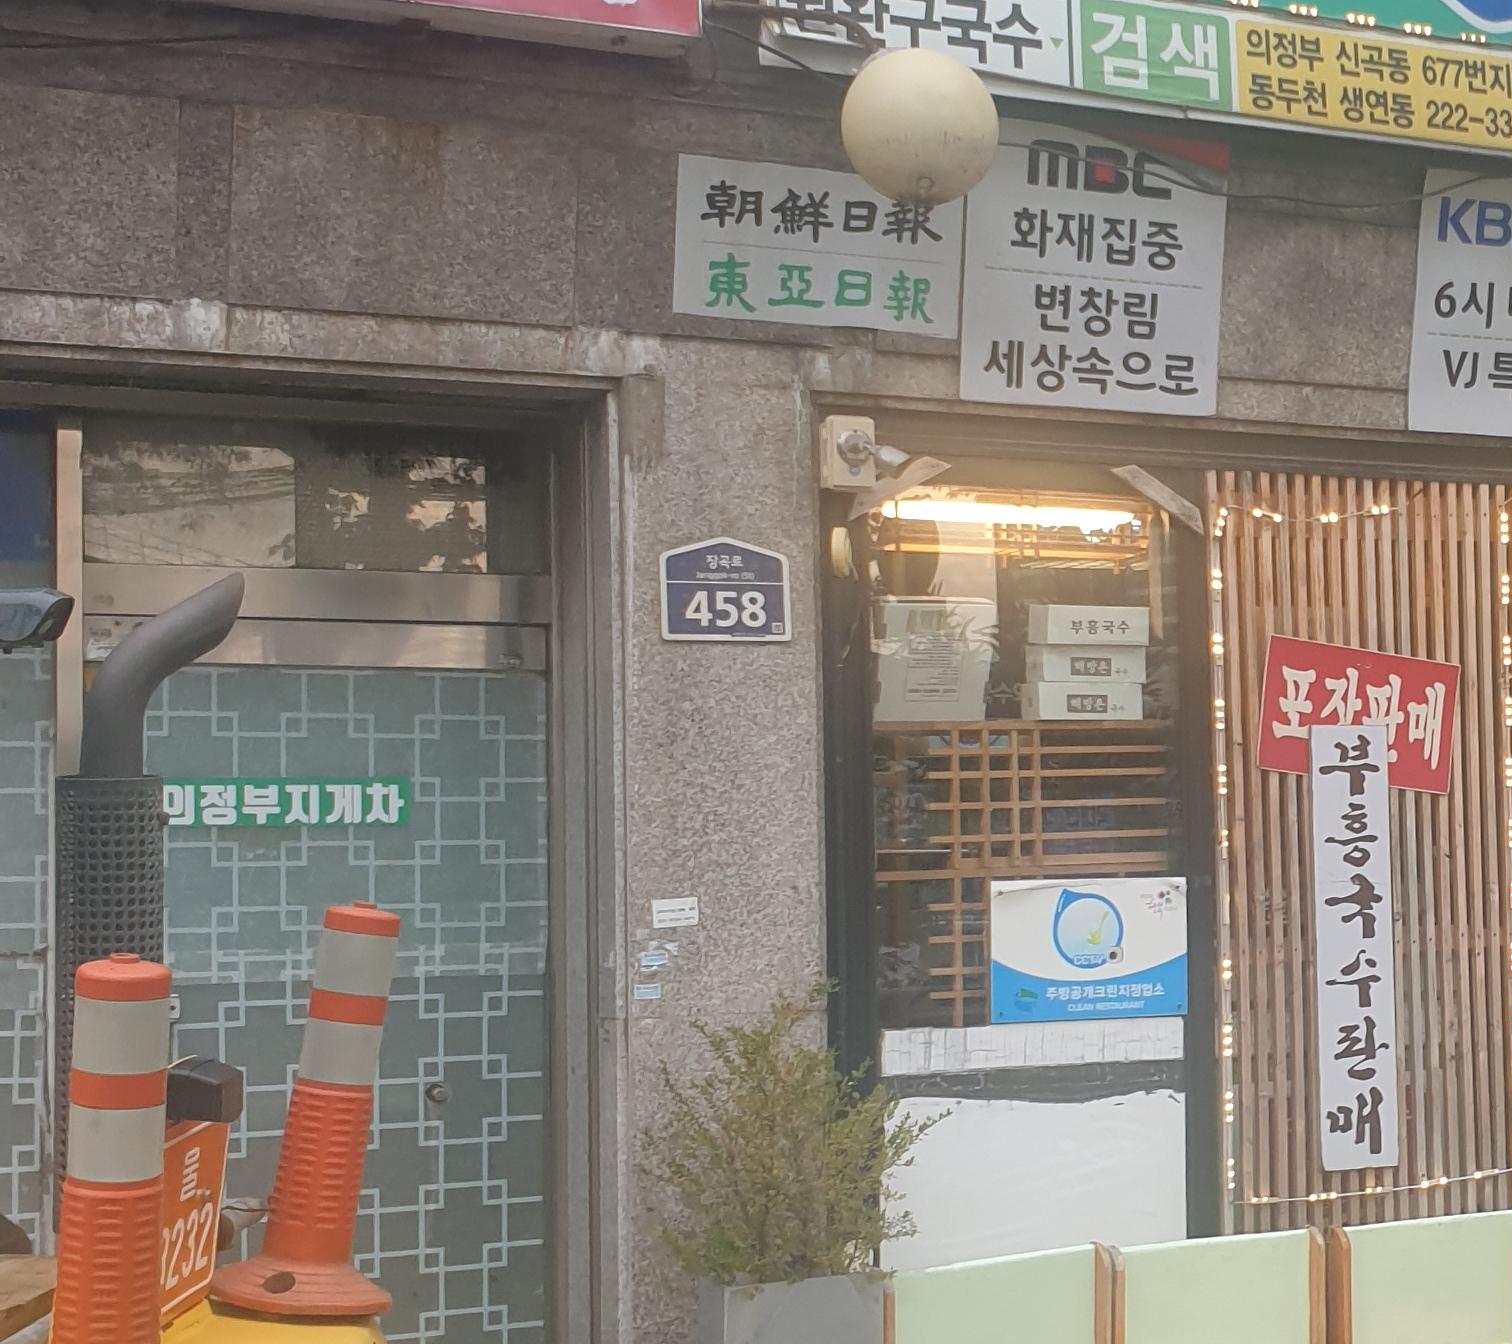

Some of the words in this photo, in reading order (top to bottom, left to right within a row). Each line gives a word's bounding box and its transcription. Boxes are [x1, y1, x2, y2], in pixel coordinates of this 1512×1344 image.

[1091, 11, 1221, 101] 검색
[1246, 29, 1324, 73] 의정부
[1336, 41, 1411, 85] 신곡동
[1422, 55, 1512, 99] 677번지
[1249, 73, 1328, 118] 동두천
[1339, 86, 1415, 129] 생연동
[1027, 139, 1173, 201] MBC
[1011, 207, 1183, 271] 화재집중
[704, 253, 934, 324] 東亞日報
[1034, 283, 1159, 340] 변창림
[1435, 281, 1495, 329] 6시
[984, 339, 1199, 397] 세상속으로
[685, 590, 767, 628] 458
[163, 783, 405, 826] 의정부지게차
